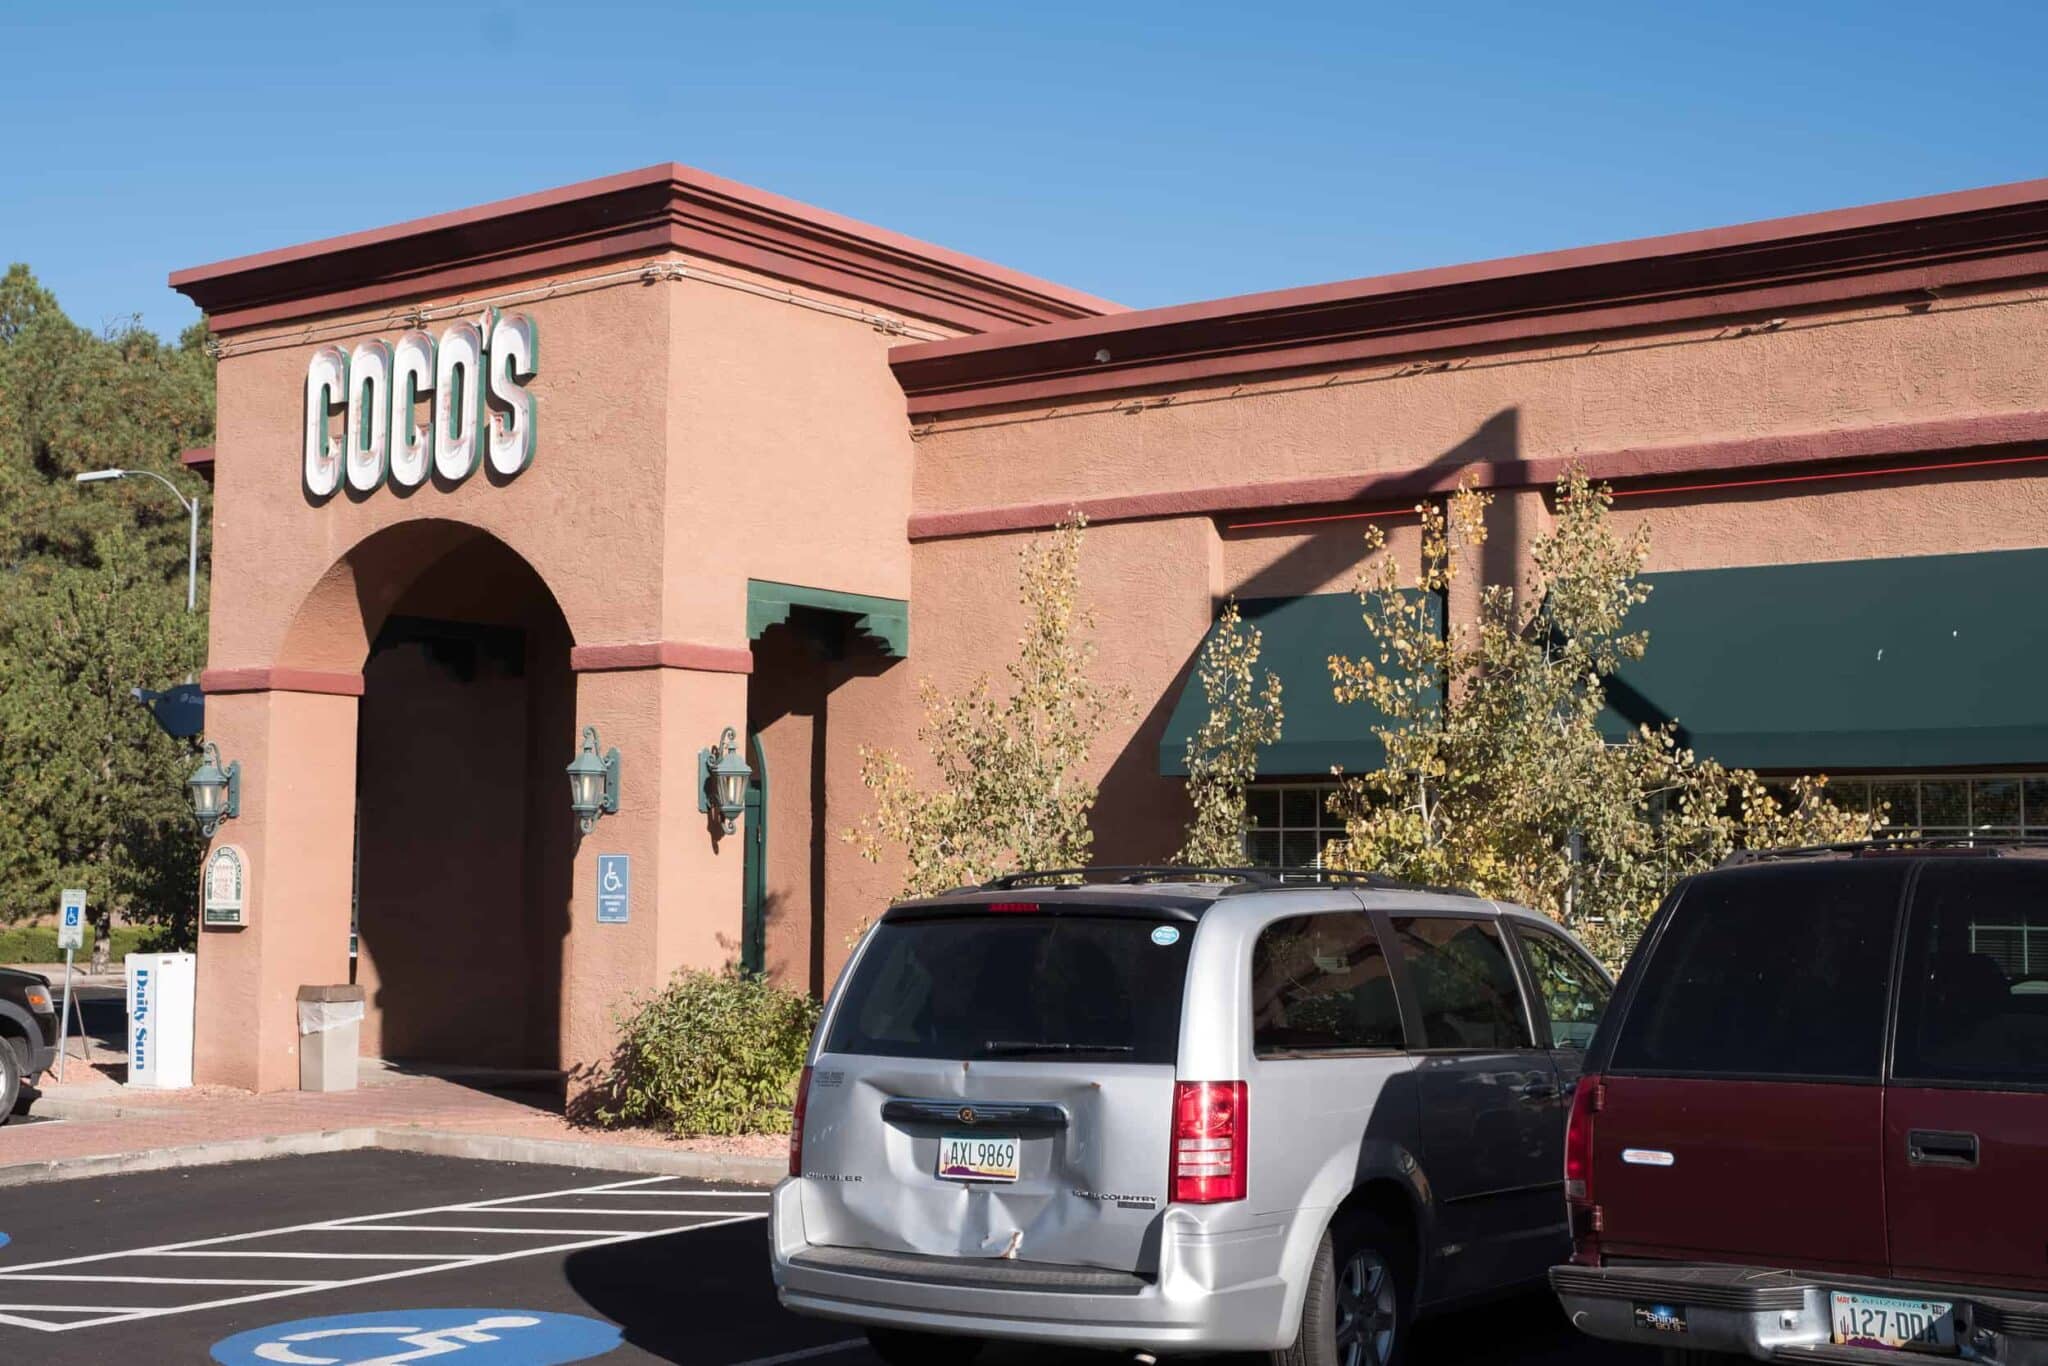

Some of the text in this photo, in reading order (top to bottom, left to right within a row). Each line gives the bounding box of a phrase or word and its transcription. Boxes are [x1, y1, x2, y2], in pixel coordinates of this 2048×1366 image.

[304, 305, 538, 496] COCO'S
[134, 970, 148, 1070] Daily Sun
[951, 1142, 1014, 1168] AXL9869
